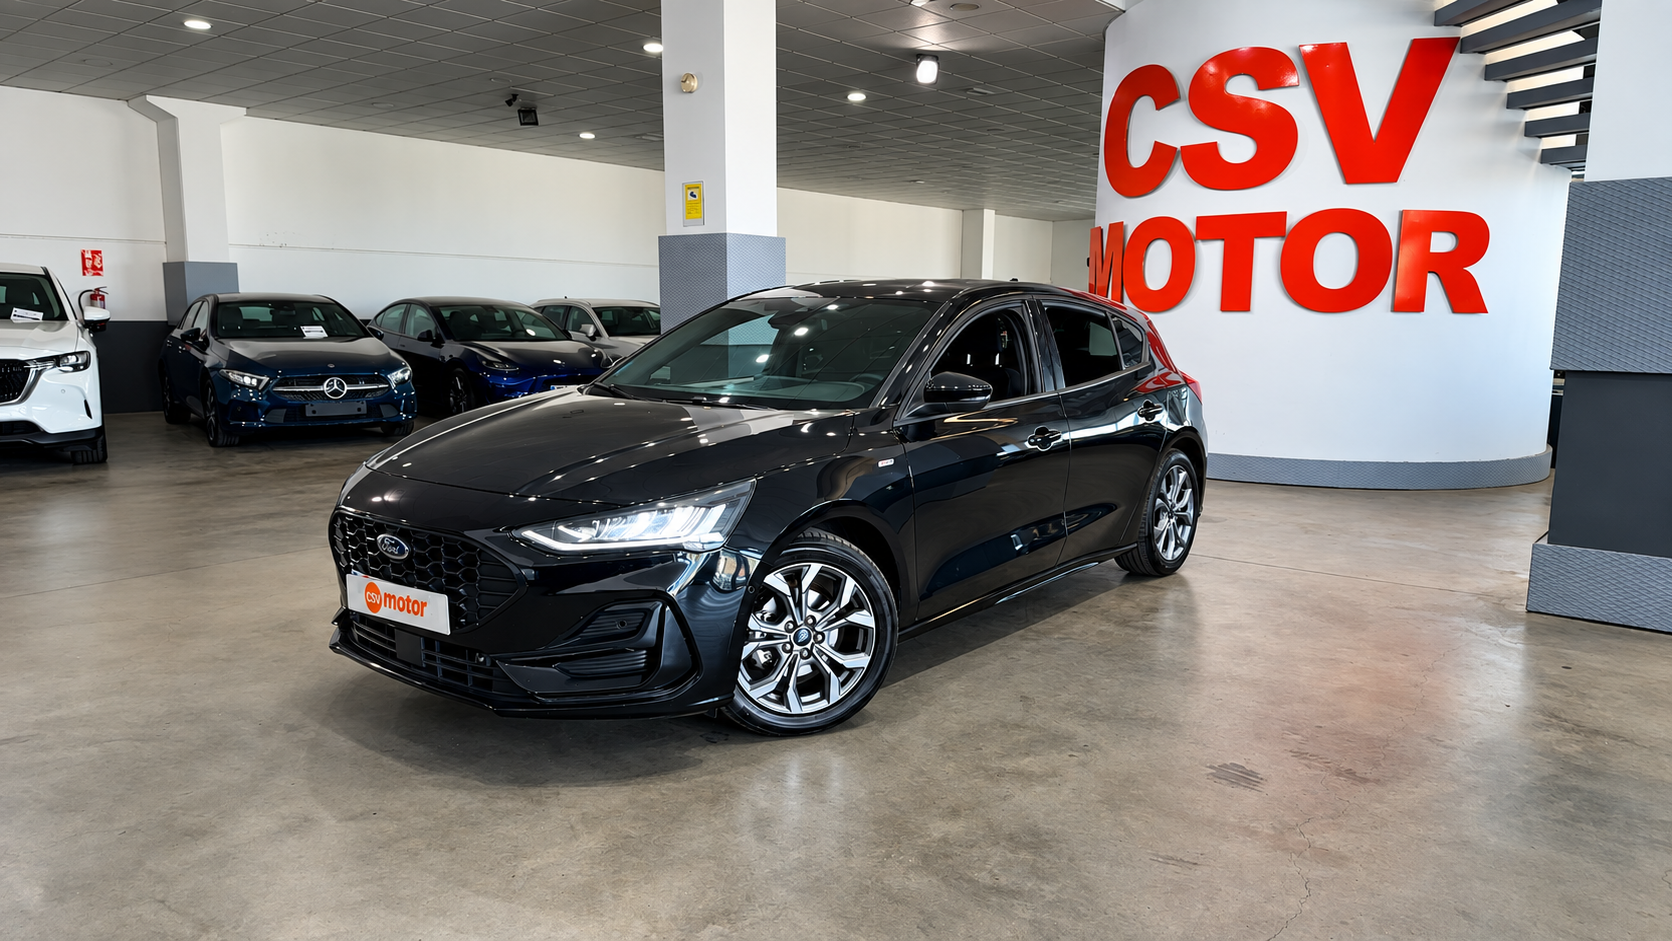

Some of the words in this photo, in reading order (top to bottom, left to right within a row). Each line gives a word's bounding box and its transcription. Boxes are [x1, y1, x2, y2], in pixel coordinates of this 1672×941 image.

[1103, 36, 1461, 199] CSV
[1089, 207, 1490, 314] MOTOR
[384, 591, 428, 618] motor
